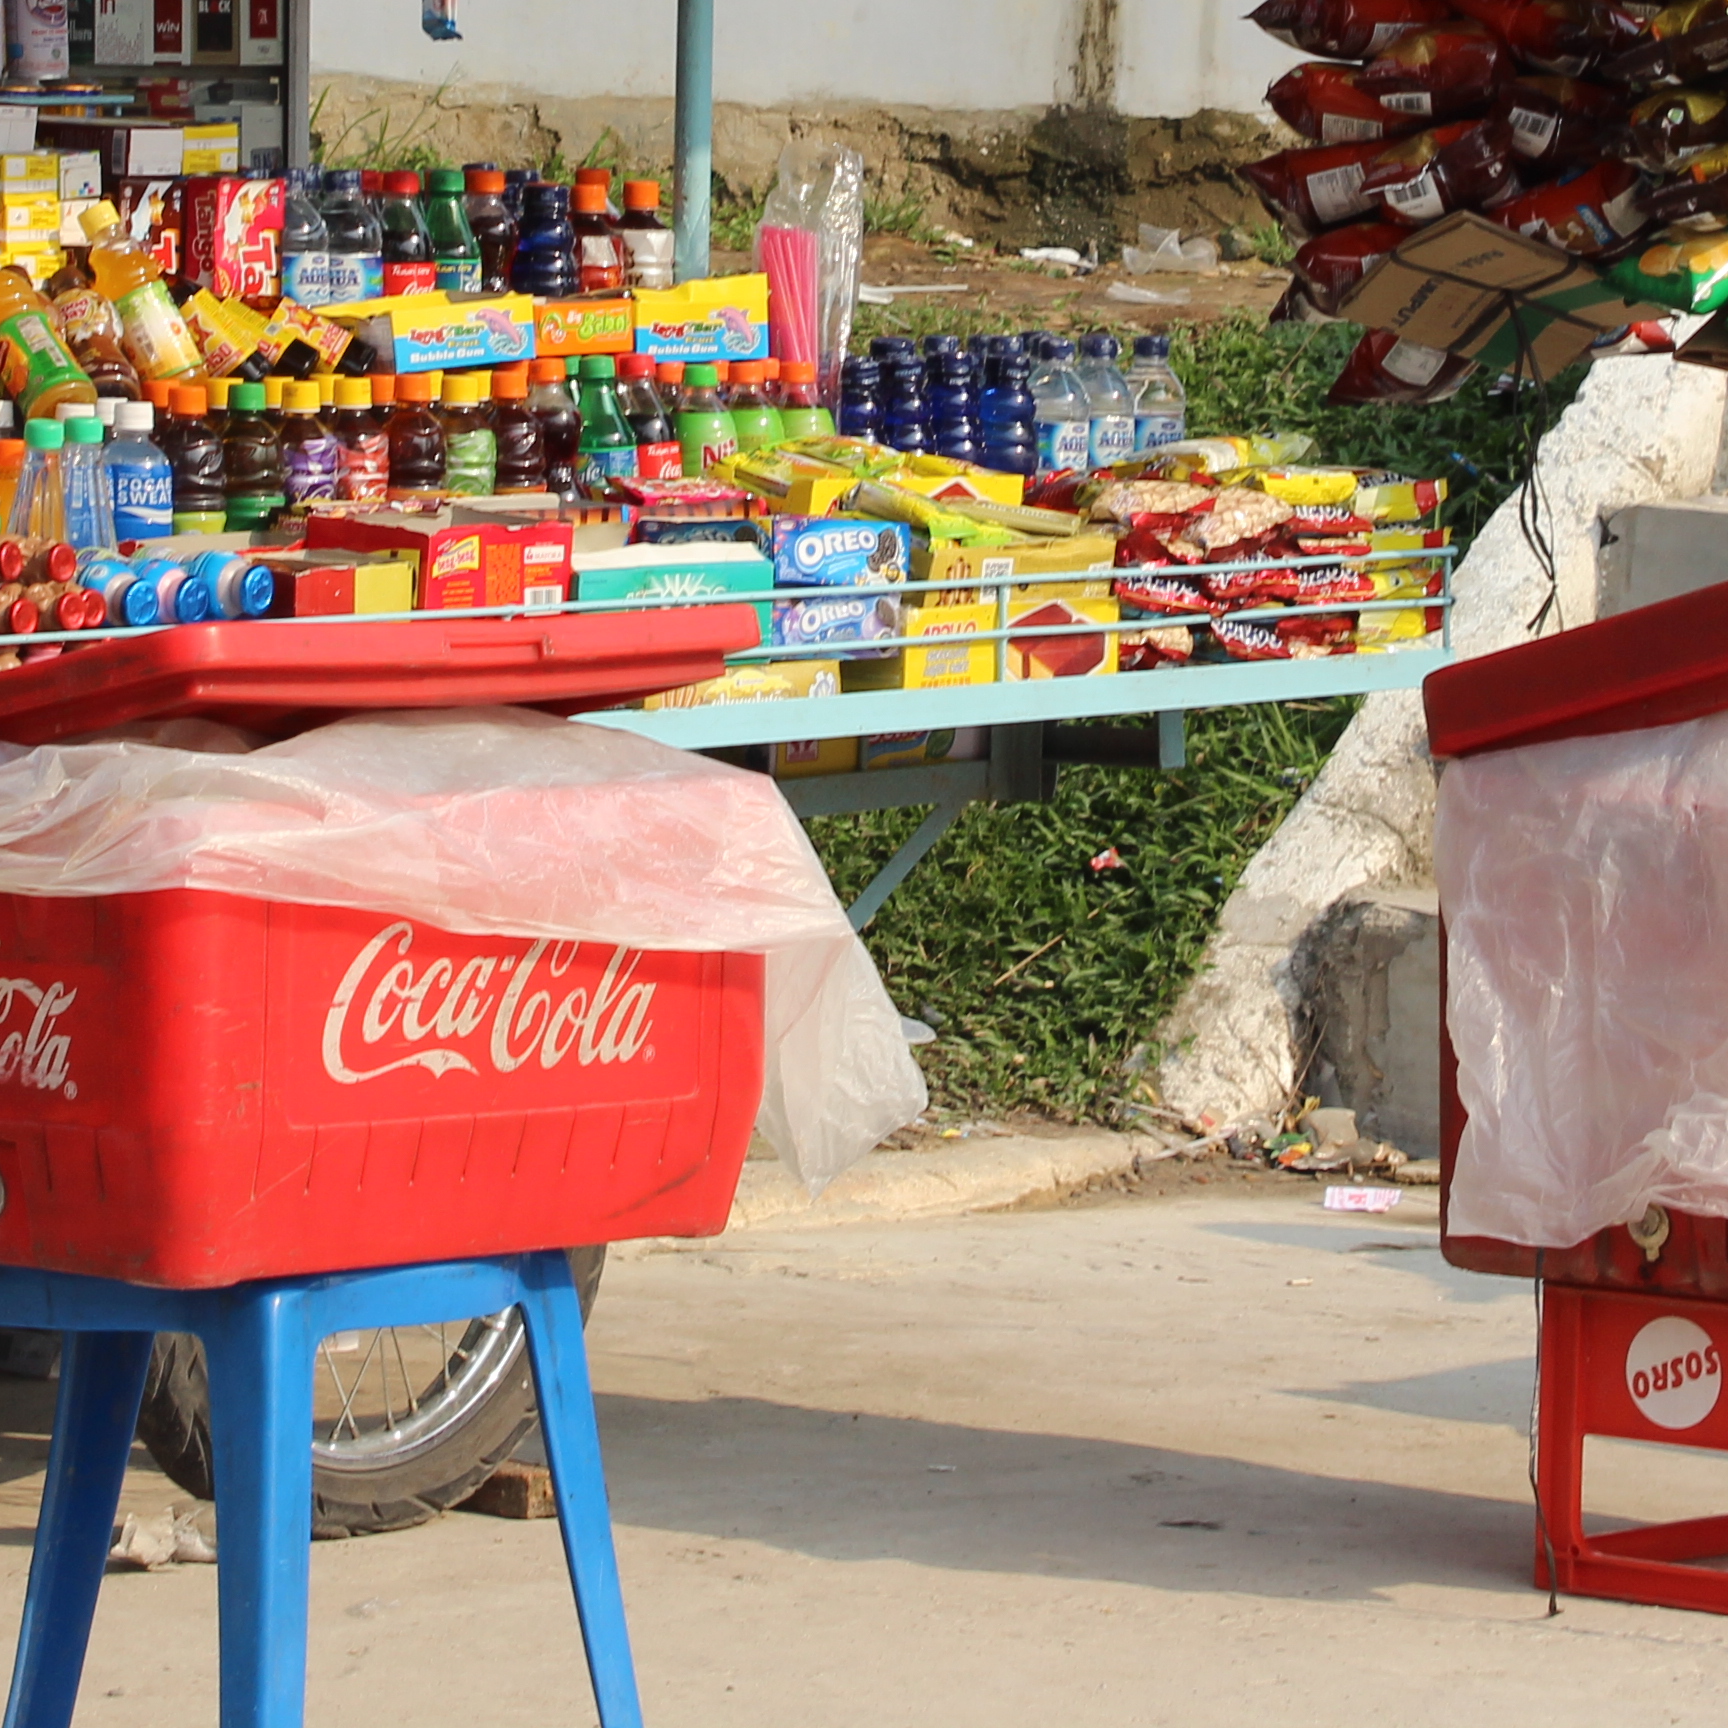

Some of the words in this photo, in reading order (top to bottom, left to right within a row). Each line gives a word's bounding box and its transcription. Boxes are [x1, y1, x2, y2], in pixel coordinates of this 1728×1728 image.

[409, 349, 455, 364] Bubble
[456, 345, 486, 359] Gum
[796, 528, 877, 566] OREO
[801, 601, 865, 634] OREO
[321, 922, 658, 1087] Coca-Cola
[1632, 1344, 1721, 1400] SOSRO
